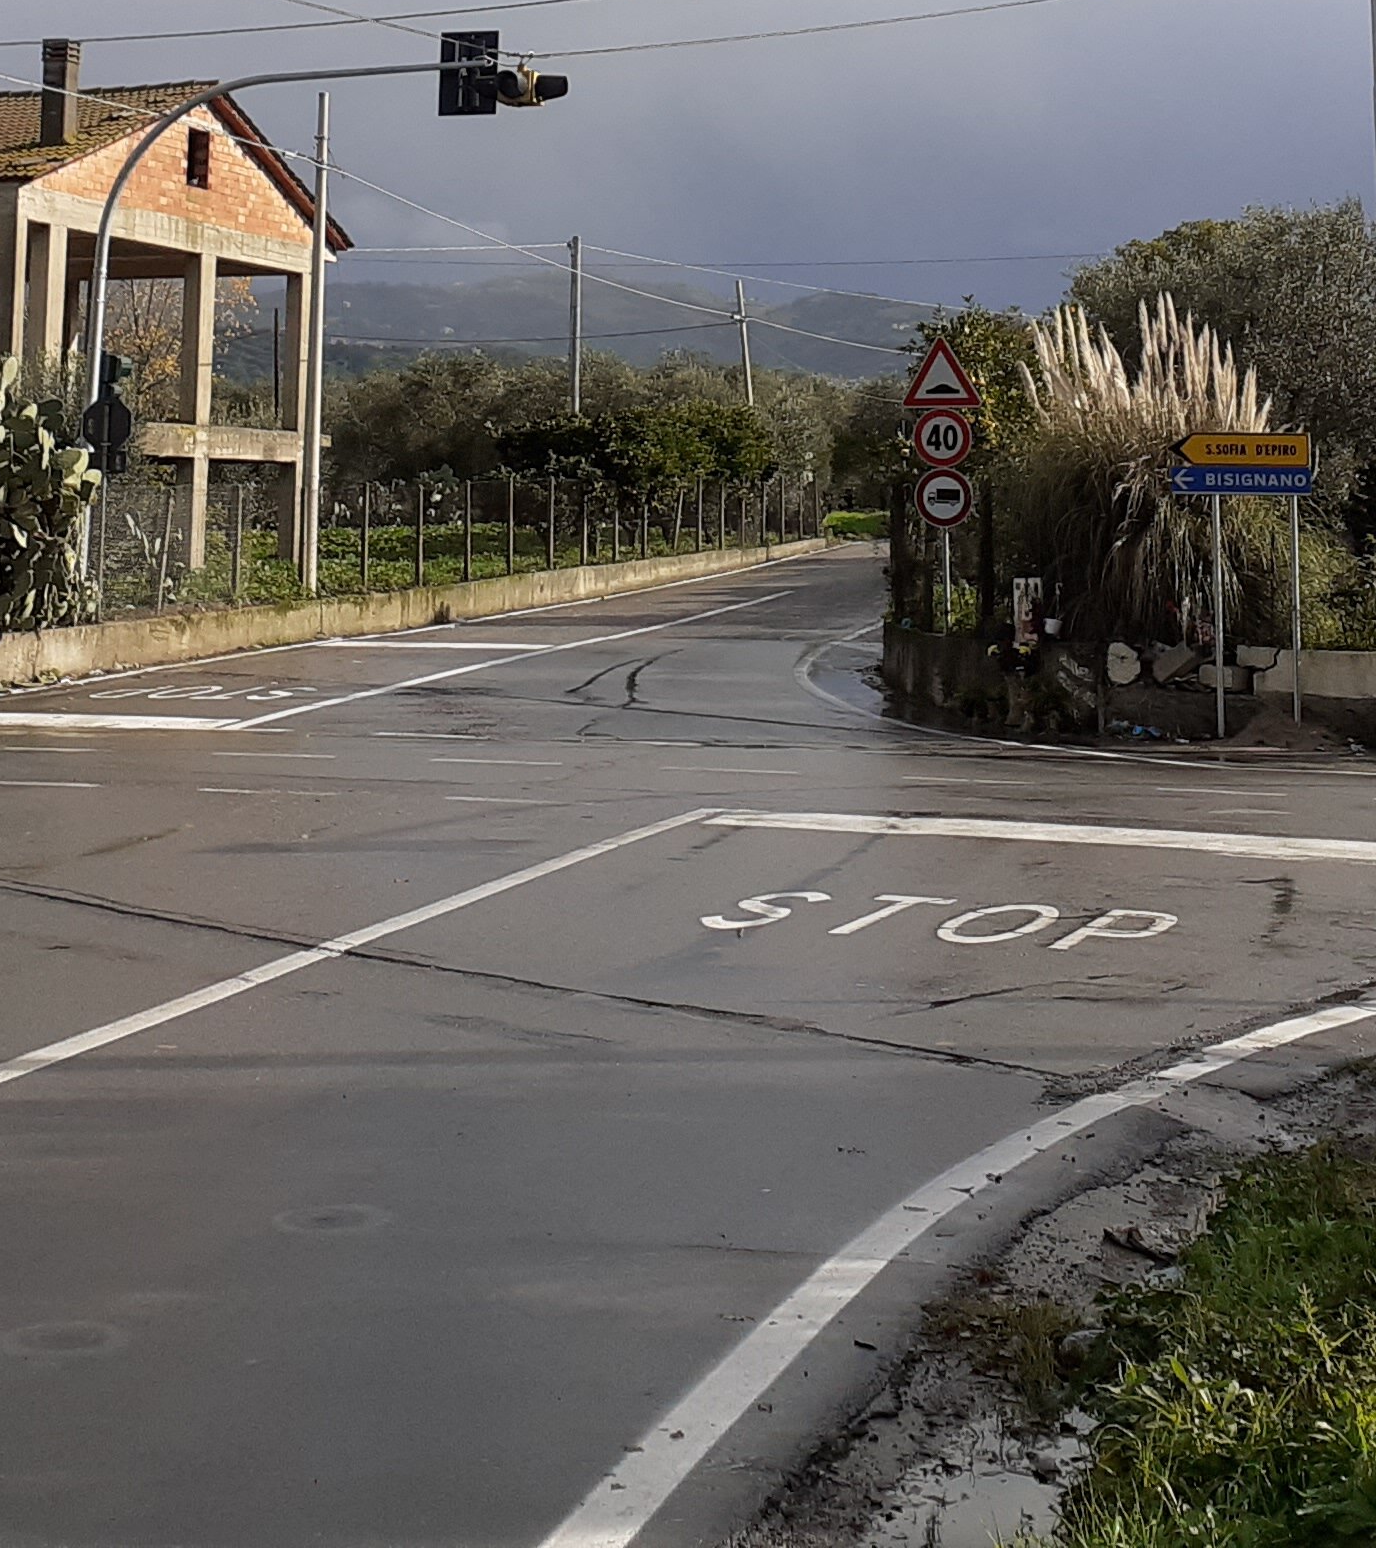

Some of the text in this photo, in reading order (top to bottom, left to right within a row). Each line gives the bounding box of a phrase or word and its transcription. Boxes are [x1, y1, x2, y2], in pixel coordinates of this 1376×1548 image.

[927, 424, 958, 451] 40
[1205, 443, 1247, 456] S.SOFIA
[1205, 473, 1307, 487] BISIGNANO
[700, 890, 1179, 950] STOP
